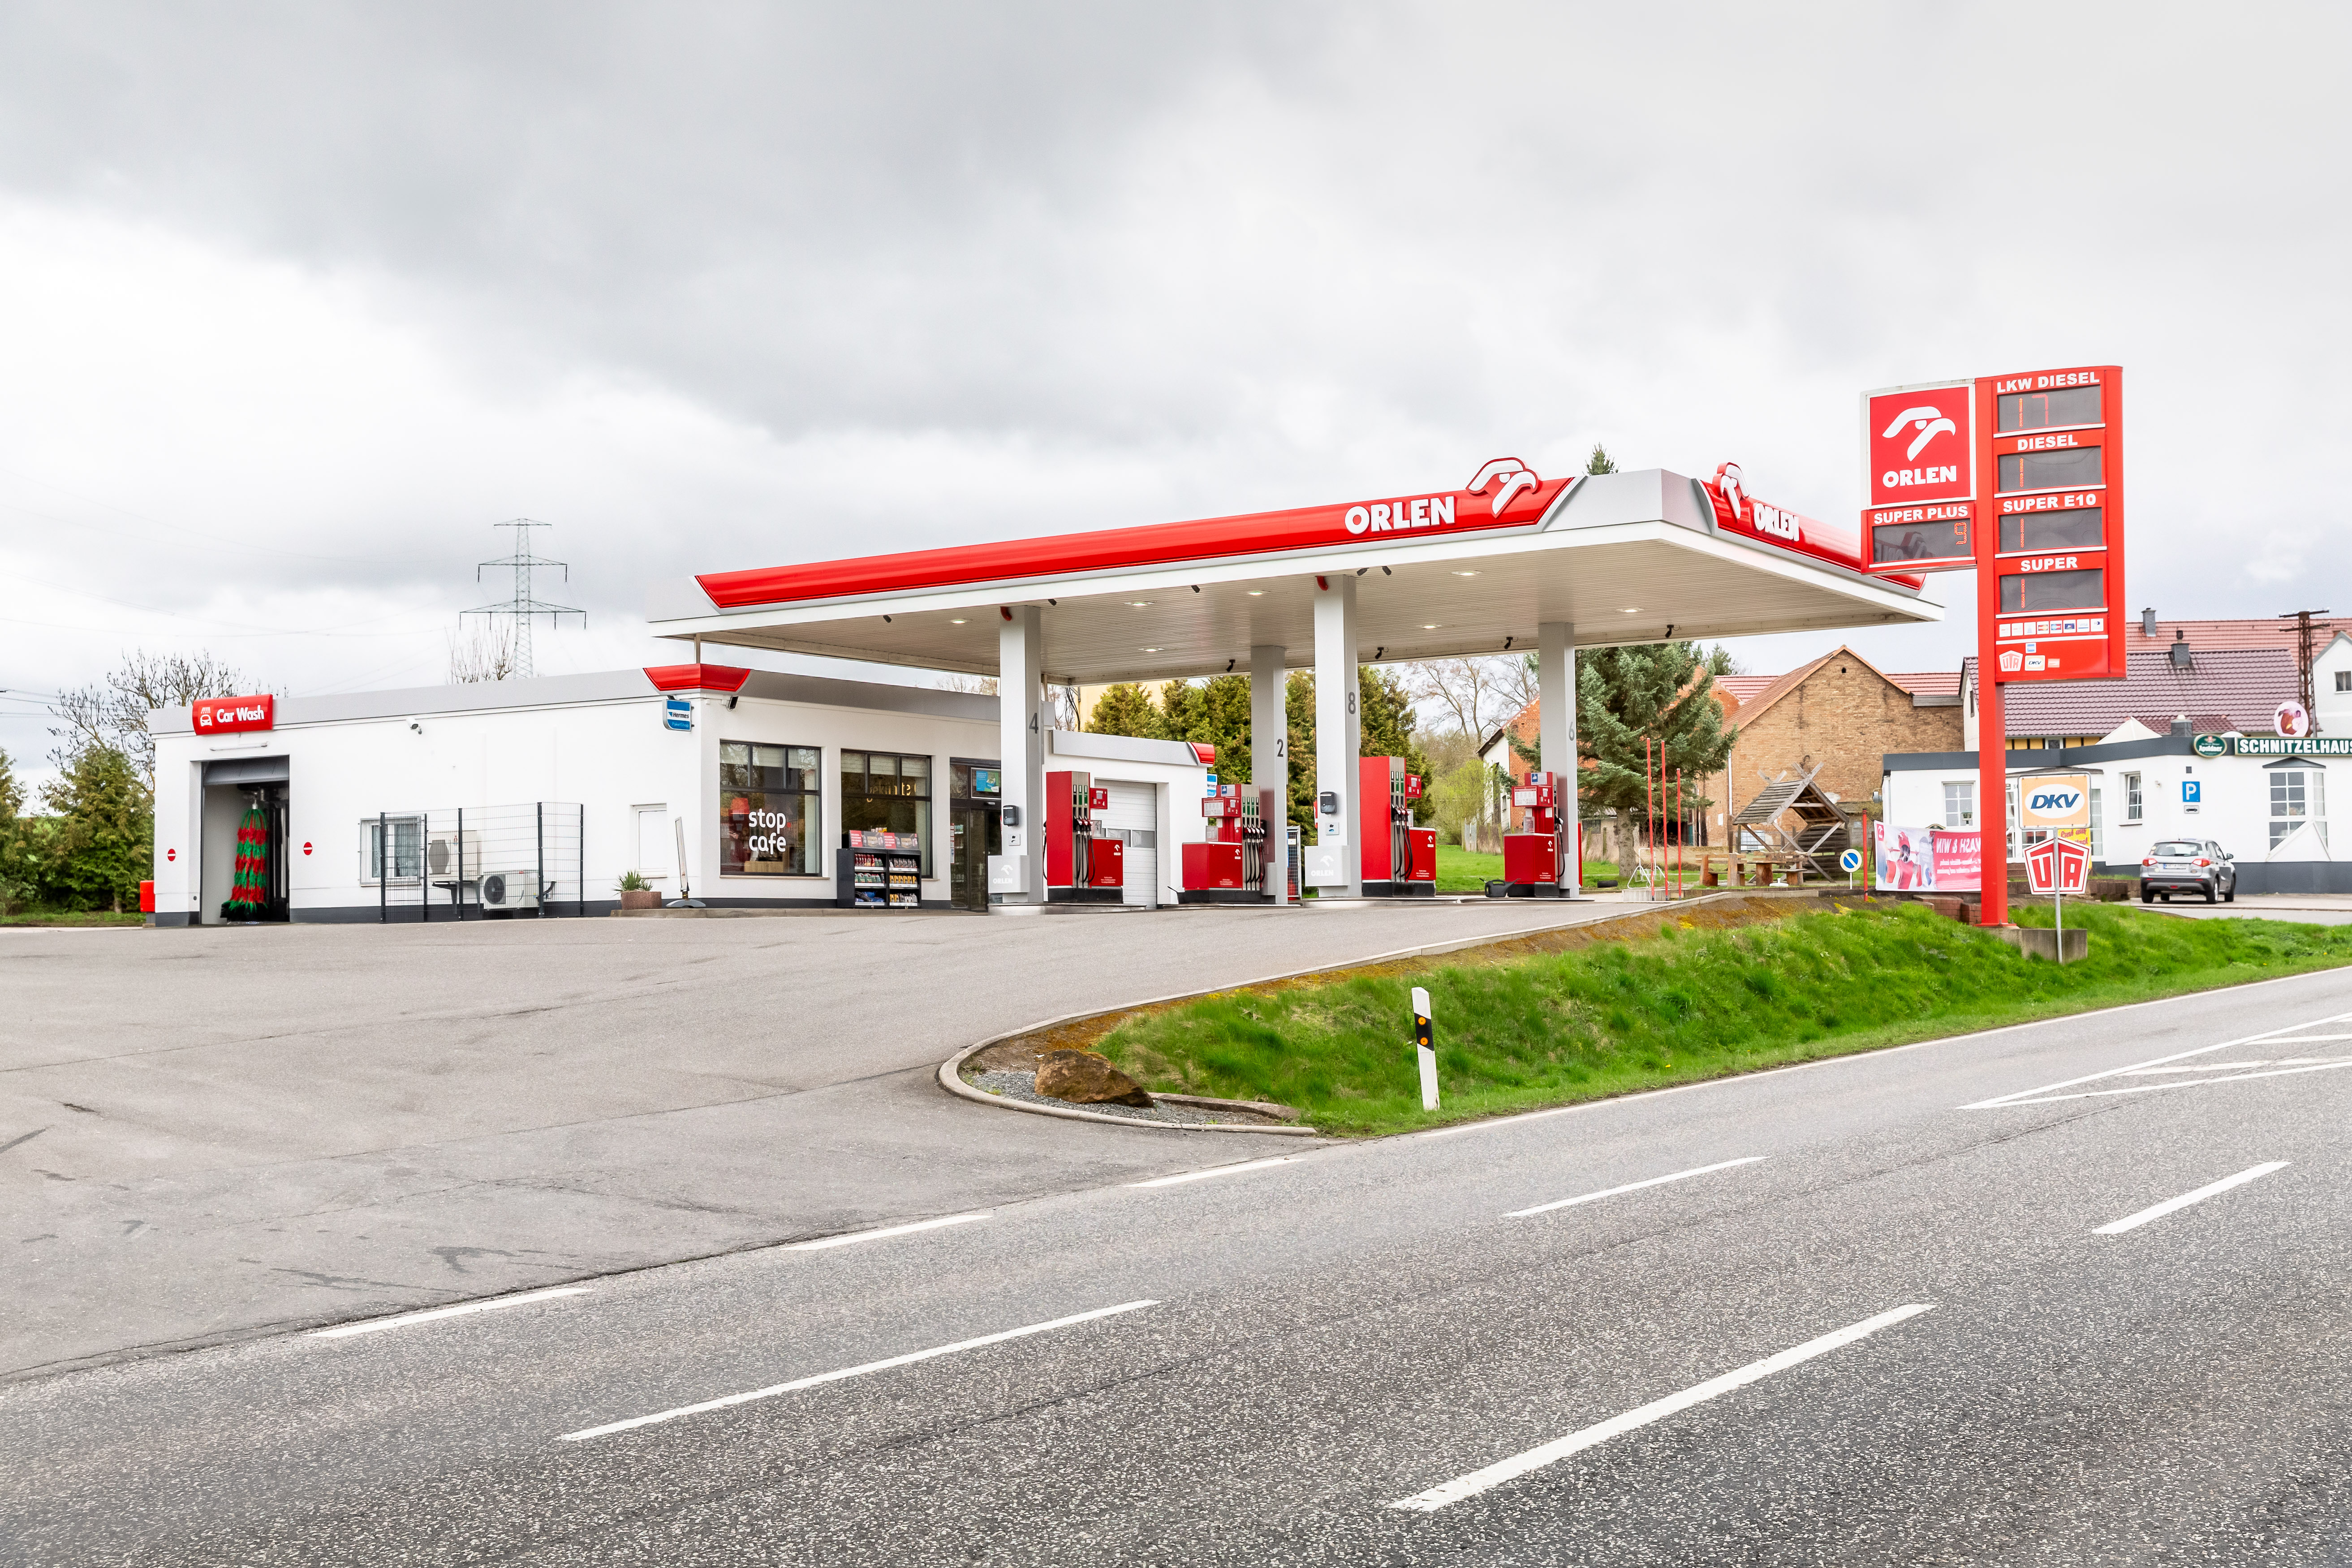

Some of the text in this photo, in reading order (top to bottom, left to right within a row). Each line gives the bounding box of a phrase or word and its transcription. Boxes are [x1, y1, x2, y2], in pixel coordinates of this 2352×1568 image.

[1997, 371, 2100, 393] LKW DIESEL
[2017, 434, 2078, 451] DIESEL
[1882, 465, 1957, 488] ORLEN
[2003, 493, 2096, 513] SUPER E10
[1344, 495, 1455, 535] ORLEN
[1753, 502, 1800, 542] ORLEN
[1874, 505, 1969, 525] SUPER PLUS
[2020, 556, 2078, 572] SUPER
[1348, 692, 1356, 715] 8
[216, 705, 264, 723] Car Wash
[1029, 712, 1039, 734] 4
[1569, 721, 1575, 741] 6
[1277, 738, 1284, 758] 2
[2240, 739, 2352, 754] SCHNITZELHAU
[2030, 793, 2080, 809] DKV
[2185, 783, 2197, 801] P
[749, 832, 787, 855] cafe
